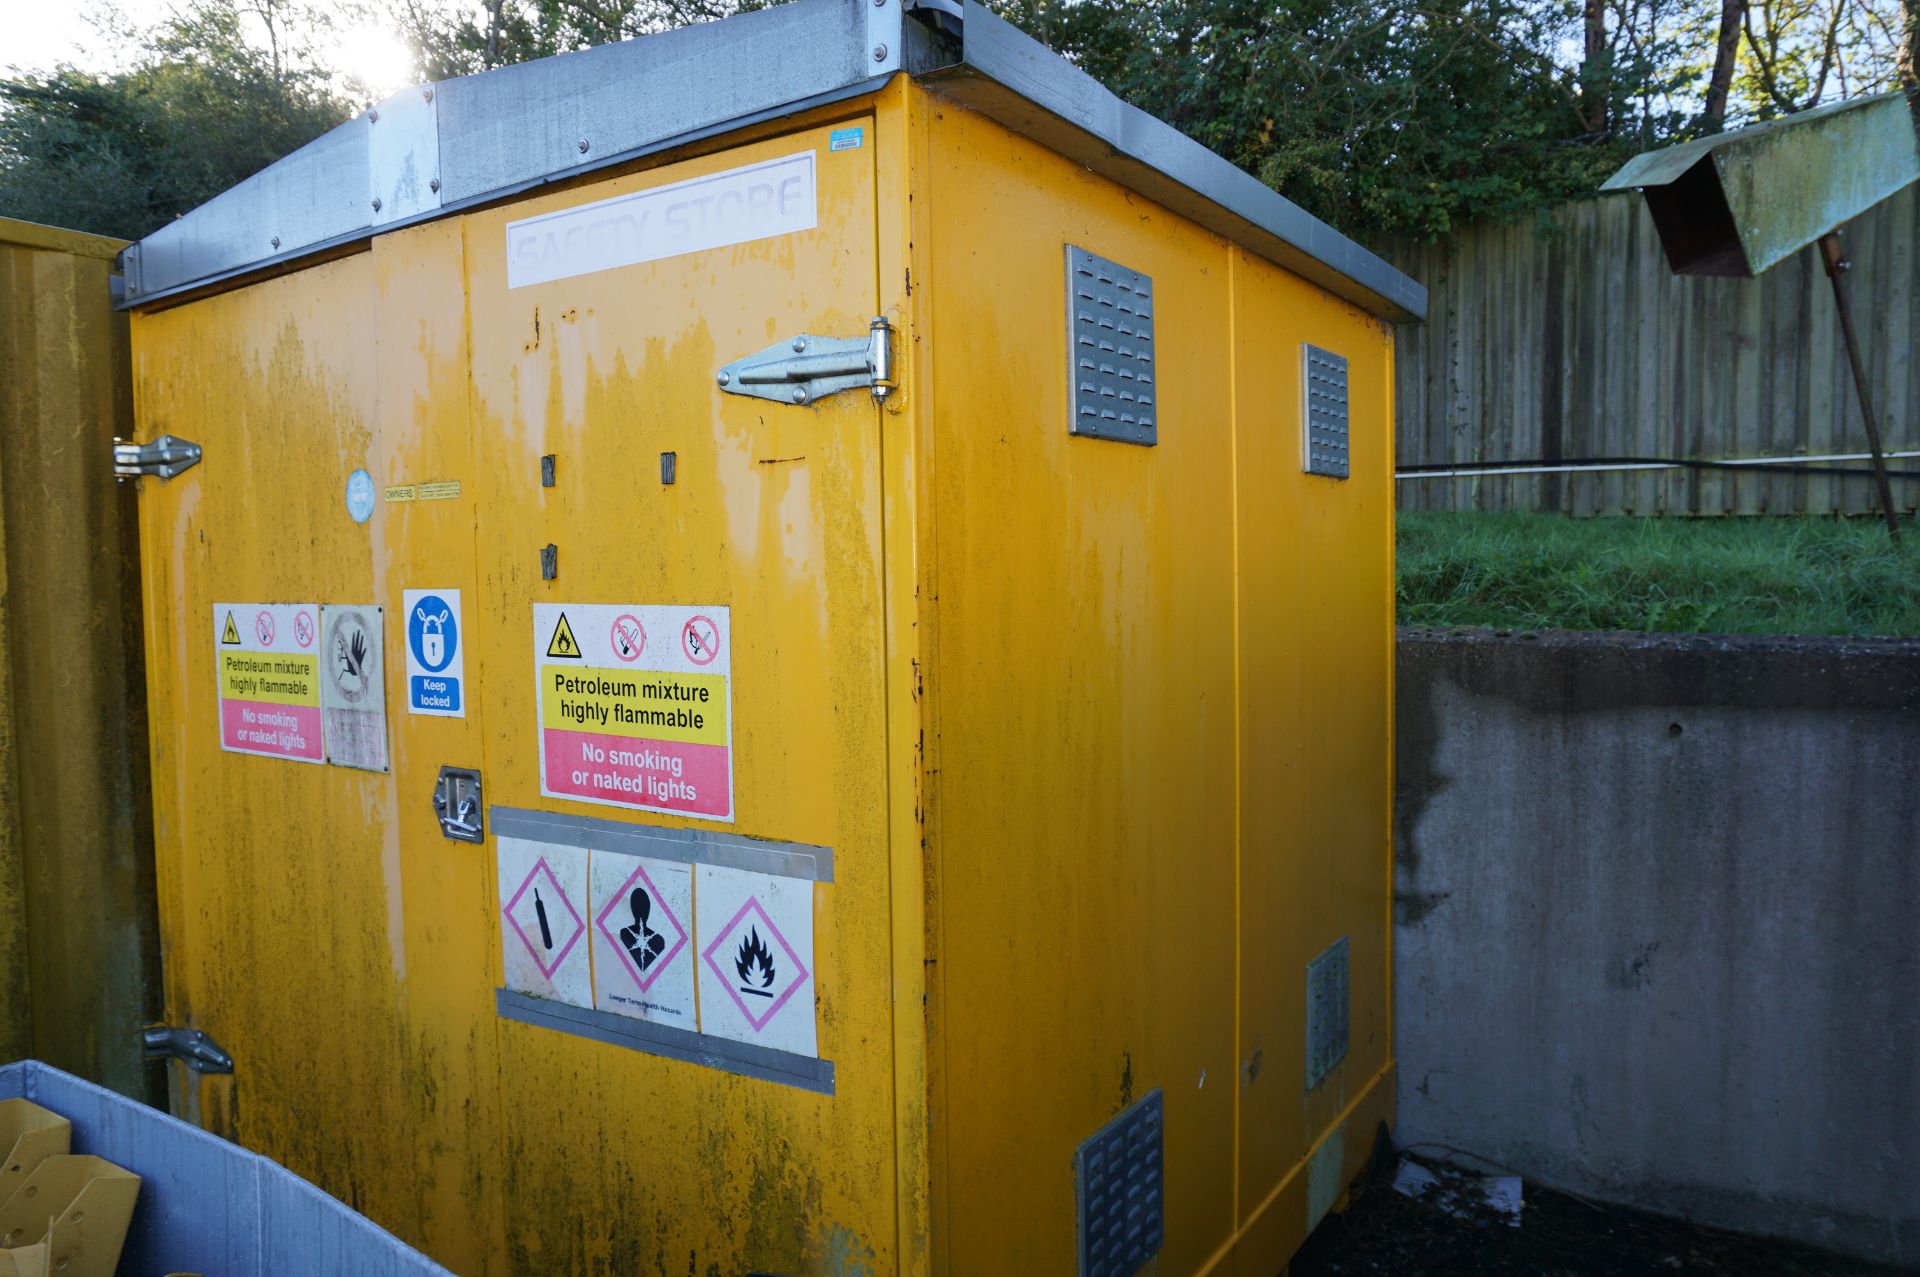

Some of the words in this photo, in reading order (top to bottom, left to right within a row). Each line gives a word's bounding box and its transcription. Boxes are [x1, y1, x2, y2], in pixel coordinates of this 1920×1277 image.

[516, 209, 650, 273] SAFETY
[664, 175, 803, 240] STORE
[386, 489, 413, 499] OWNERS
[226, 657, 272, 673] Petroleum
[274, 660, 310, 675] mixture
[230, 676, 257, 694] highly
[259, 678, 308, 695] flammable
[423, 678, 446, 693] Keep
[555, 674, 637, 698] Petroleum
[642, 681, 709, 703] mixture
[421, 694, 450, 707] locked
[242, 708, 256, 723] No
[257, 712, 298, 732] smoking
[561, 700, 609, 726] highly
[614, 703, 704, 729] flammable
[237, 729, 248, 740] or
[249, 729, 277, 745] naked
[279, 731, 306, 750] lights
[582, 742, 605, 763] No
[609, 749, 682, 778] smoking
[572, 770, 588, 786] or
[593, 771, 643, 794] naked
[647, 776, 697, 802] lights
[628, 998, 641, 1006] Term
[660, 1005, 682, 1015] Hazards
